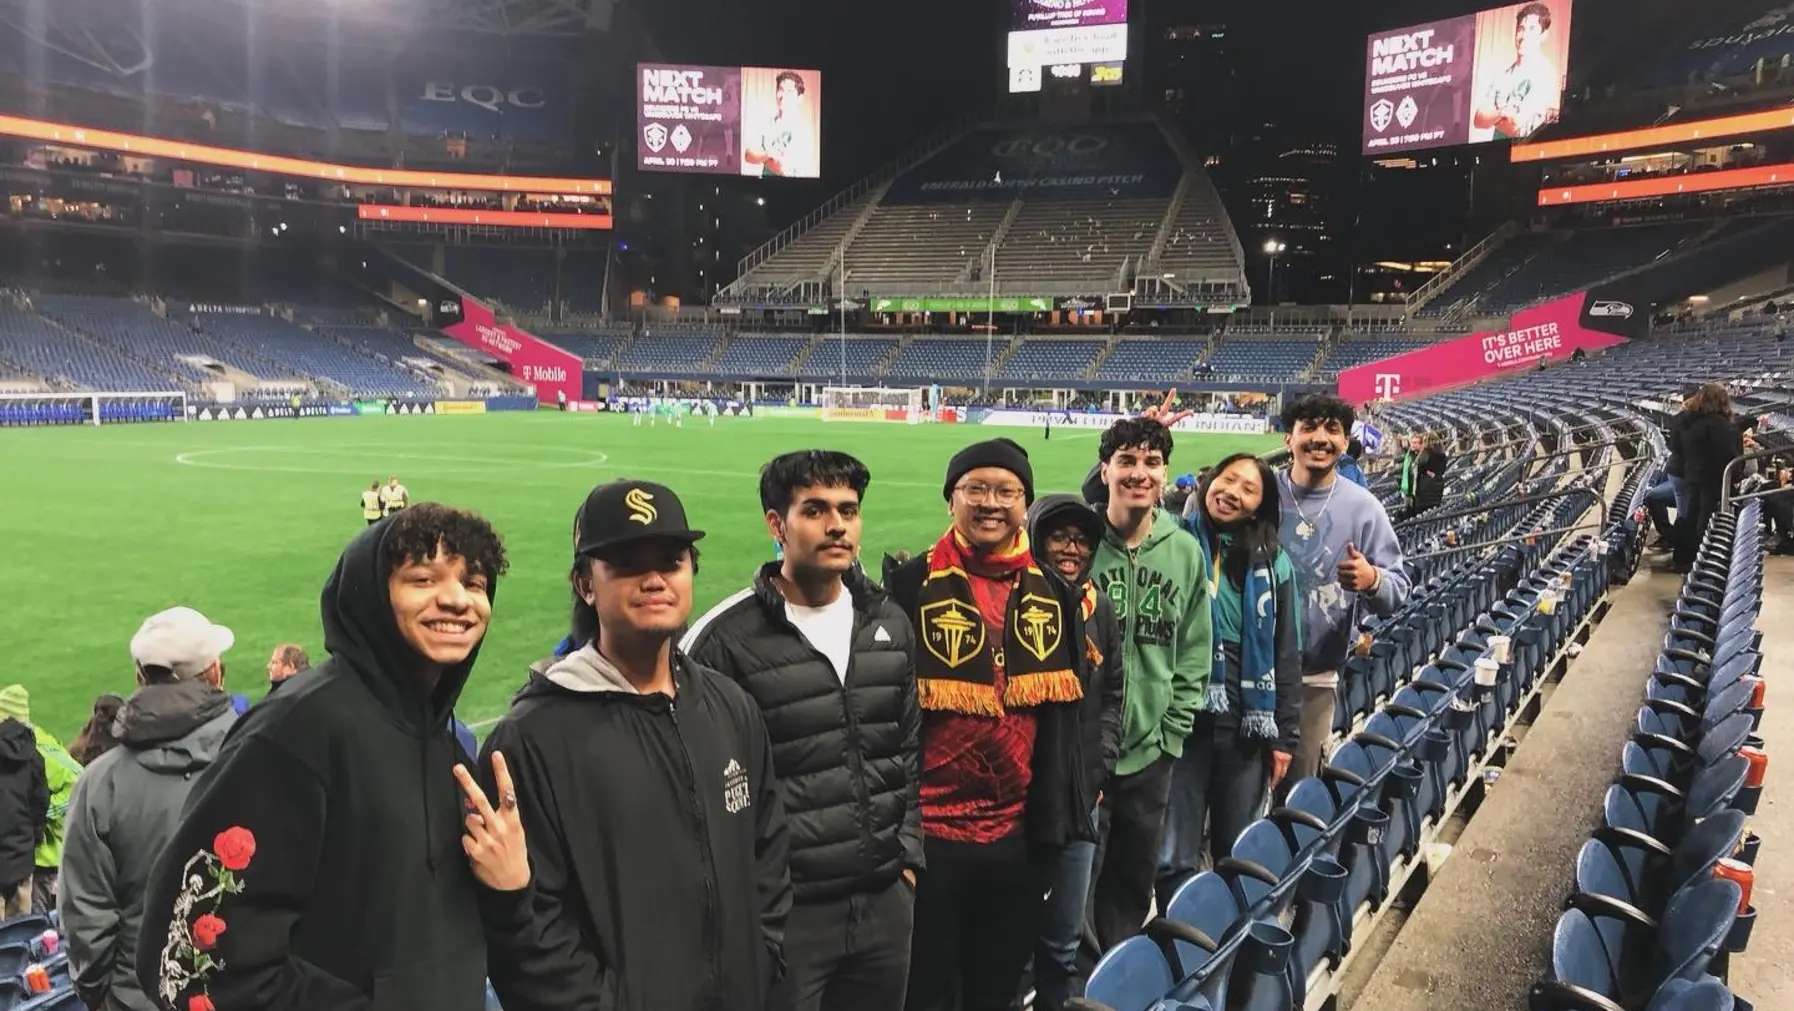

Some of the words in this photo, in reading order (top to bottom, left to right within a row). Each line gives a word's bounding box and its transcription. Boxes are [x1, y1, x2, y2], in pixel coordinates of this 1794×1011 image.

[1373, 29, 1435, 58] NEXT
[1371, 44, 1454, 76] MATCH
[643, 69, 704, 88] NEXT
[420, 82, 546, 114] EQC
[643, 85, 722, 105] MATCH
[920, 179, 988, 191] EMERALD
[1038, 175, 1097, 187] CASINO
[1097, 173, 1144, 184] PITCH
[197, 303, 222, 314] DELTA
[1481, 334, 1506, 351] IT'S
[1508, 322, 1559, 346] BETTER
[1484, 345, 1523, 364] OVER
[1524, 334, 1562, 356] HERE
[533, 365, 567, 382] Mobile
[306, 406, 328, 416] DELTA
[1099, 566, 1180, 606] ATIONAL
[931, 631, 942, 643] 19
[964, 634, 977, 646] 74
[1023, 625, 1033, 636] 19
[1046, 625, 1057, 636] 74
